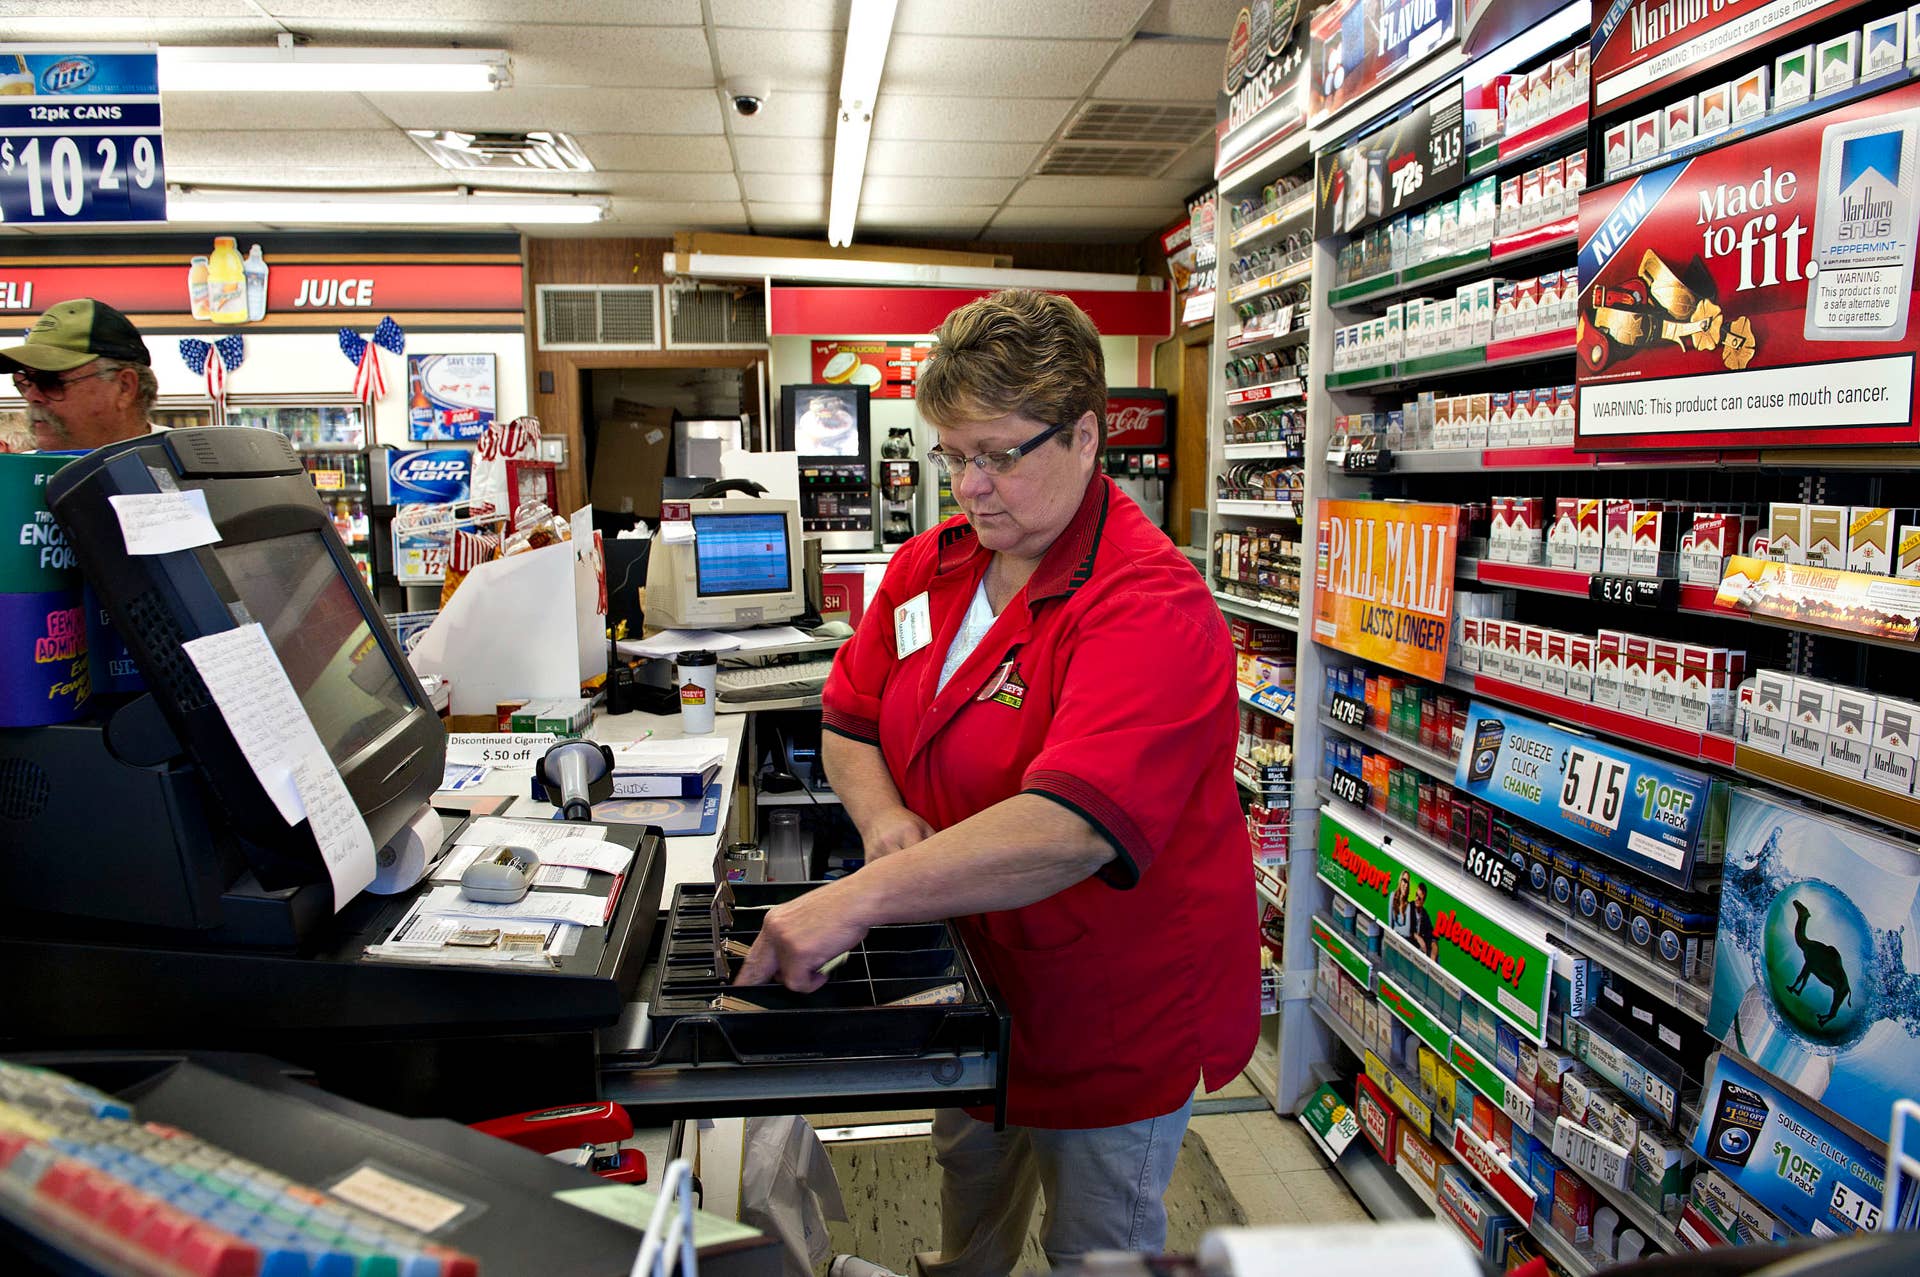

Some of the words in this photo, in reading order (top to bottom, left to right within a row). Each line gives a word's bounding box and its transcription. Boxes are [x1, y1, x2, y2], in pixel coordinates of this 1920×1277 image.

[1601, 0, 1634, 36] NEW
[1648, 49, 1689, 75] WARNING:
[1691, 38, 1708, 57] This
[1709, 27, 1742, 52] product
[1743, 16, 1761, 34] can
[1763, 8, 1791, 28] cause
[53, 65, 91, 91] Lite
[1229, 62, 1274, 131] CHOOSE
[29, 106, 70, 122] 12pk
[73, 106, 122, 120] CANS
[1428, 127, 1463, 168] $5.15
[1392, 160, 1424, 209] 72's
[1696, 167, 1798, 226] Made
[1840, 186, 1893, 223] Marlboro
[1591, 186, 1647, 266] NEW
[1839, 219, 1891, 241] snus
[1703, 225, 1736, 259] to
[1735, 213, 1820, 292] fit.
[1830, 241, 1897, 255] PEPPERMINT
[1836, 270, 1882, 284] WARNING:
[293, 278, 375, 308] JUICE
[1820, 286, 1837, 297] This
[1839, 285, 1871, 300] product
[1873, 285, 1880, 295] is
[1883, 284, 1897, 295] not
[1830, 299, 1847, 309] safe
[1848, 297, 1890, 309] alternative
[1828, 312, 1836, 322] to
[1838, 311, 1882, 324] cigarettes.
[1592, 398, 1647, 418] WARNING:
[1650, 397, 1672, 415] This
[1675, 396, 1718, 421] product
[1720, 396, 1743, 411] can
[1746, 394, 1785, 410] cause
[1788, 387, 1833, 406] mouth
[1836, 384, 1890, 405] cancer.
[399, 470, 469, 481] LIGHT
[409, 460, 465, 471] BUD
[1327, 517, 1377, 602] PALL
[1381, 520, 1449, 618] MALL
[1811, 571, 1840, 591] Blend
[1360, 604, 1394, 640] LASTS
[1396, 611, 1445, 654] LONGER
[1753, 714, 1780, 740] Marlboro
[1791, 726, 1820, 753] Marlboro
[450, 735, 513, 746] Discontinued
[1508, 735, 1554, 762] SQUEEZE
[1830, 737, 1862, 765] Marlboro
[482, 749, 510, 763] $.50
[512, 749, 531, 761] off
[1511, 756, 1541, 780] CLICK
[1873, 750, 1908, 779] Marlboro
[1503, 775, 1543, 803] CHANGE
[1635, 776, 1657, 820] $1
[1657, 784, 1694, 814] OFF
[1560, 810, 1590, 830] SPECIAL
[1589, 818, 1612, 838] PRICE
[1331, 833, 1391, 897] Newport
[1467, 847, 1504, 889] $6.15
[1432, 909, 1526, 988] pleasure!
[1572, 964, 1585, 1013] Newport
[1565, 1081, 1578, 1096] USA
[1727, 1085, 1761, 1103] CAMEL
[1368, 1102, 1384, 1128] RED
[1591, 1099, 1606, 1115] USA
[1613, 1112, 1627, 1127] USA
[1749, 1112, 1766, 1122] OFF
[1367, 1115, 1384, 1140] MAN
[1420, 1150, 1434, 1168] MAN
[1640, 1138, 1656, 1156] USA
[1777, 1112, 1818, 1147] SQUEEZE
[1819, 1142, 1850, 1168] CLICK
[1850, 1162, 1884, 1194] CHANG
[1465, 1149, 1492, 1179] PRIX
[1602, 1152, 1619, 1172] PLUS
[1602, 1167, 1617, 1183] TAX
[1772, 1141, 1792, 1177] $1
[1790, 1155, 1822, 1184] OFF
[1695, 1178, 1706, 1191] USA
[1708, 1182, 1727, 1201] USA
[1443, 1180, 1458, 1199] RED
[1463, 1200, 1479, 1223] MAN
[1741, 1210, 1760, 1229] USA
[1829, 1207, 1855, 1228] SPECIAL
